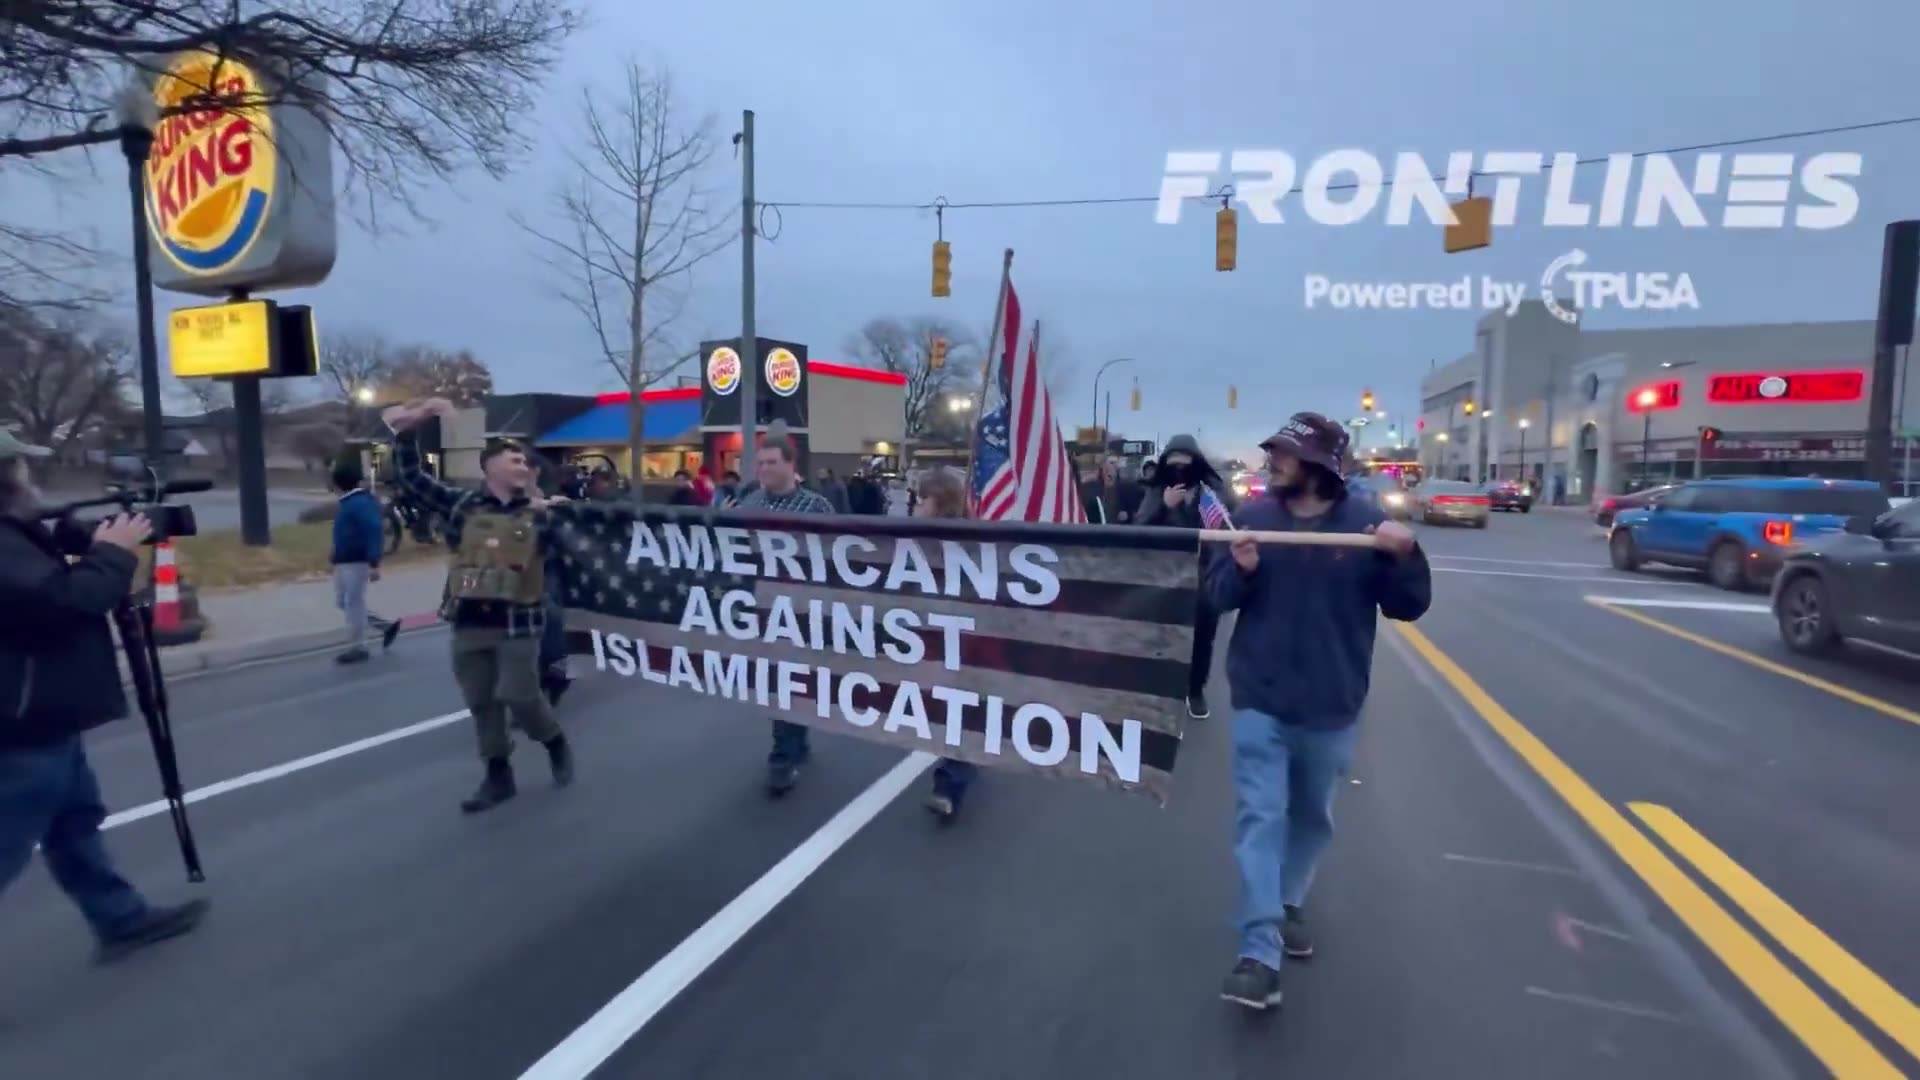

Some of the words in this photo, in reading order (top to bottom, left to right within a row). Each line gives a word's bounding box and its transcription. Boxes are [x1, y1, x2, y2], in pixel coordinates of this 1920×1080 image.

[156, 117, 253, 233] KING
[625, 521, 1061, 607] AMERICANS
[679, 586, 976, 672] AGAINST
[590, 628, 1143, 784] ISLAMIFICATION
